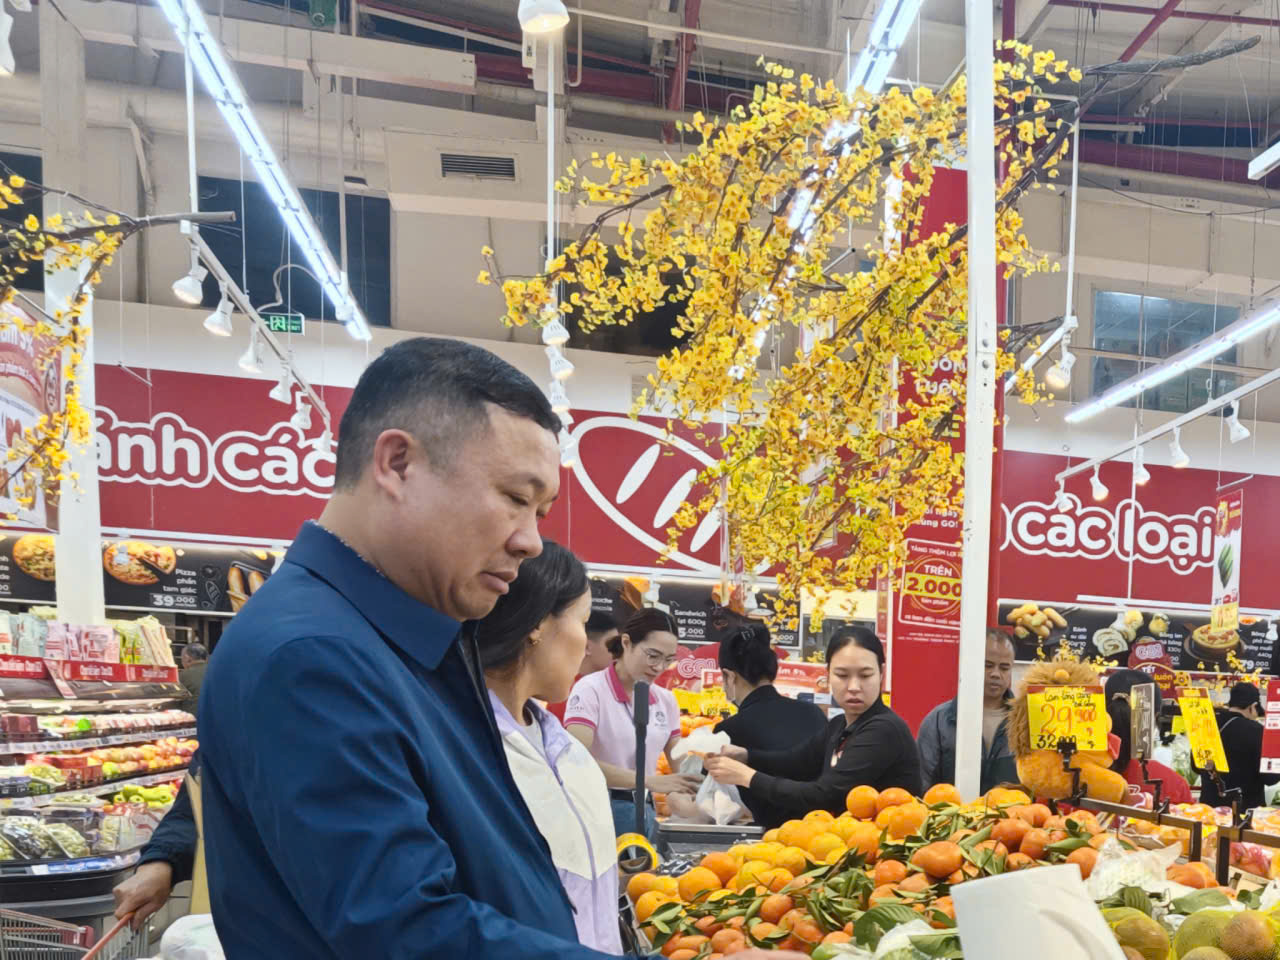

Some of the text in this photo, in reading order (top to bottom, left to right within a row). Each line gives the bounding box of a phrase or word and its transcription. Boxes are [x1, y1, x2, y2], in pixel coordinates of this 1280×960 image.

[1018, 500, 1212, 566] các loại
[924, 564, 952, 577] TRÊN
